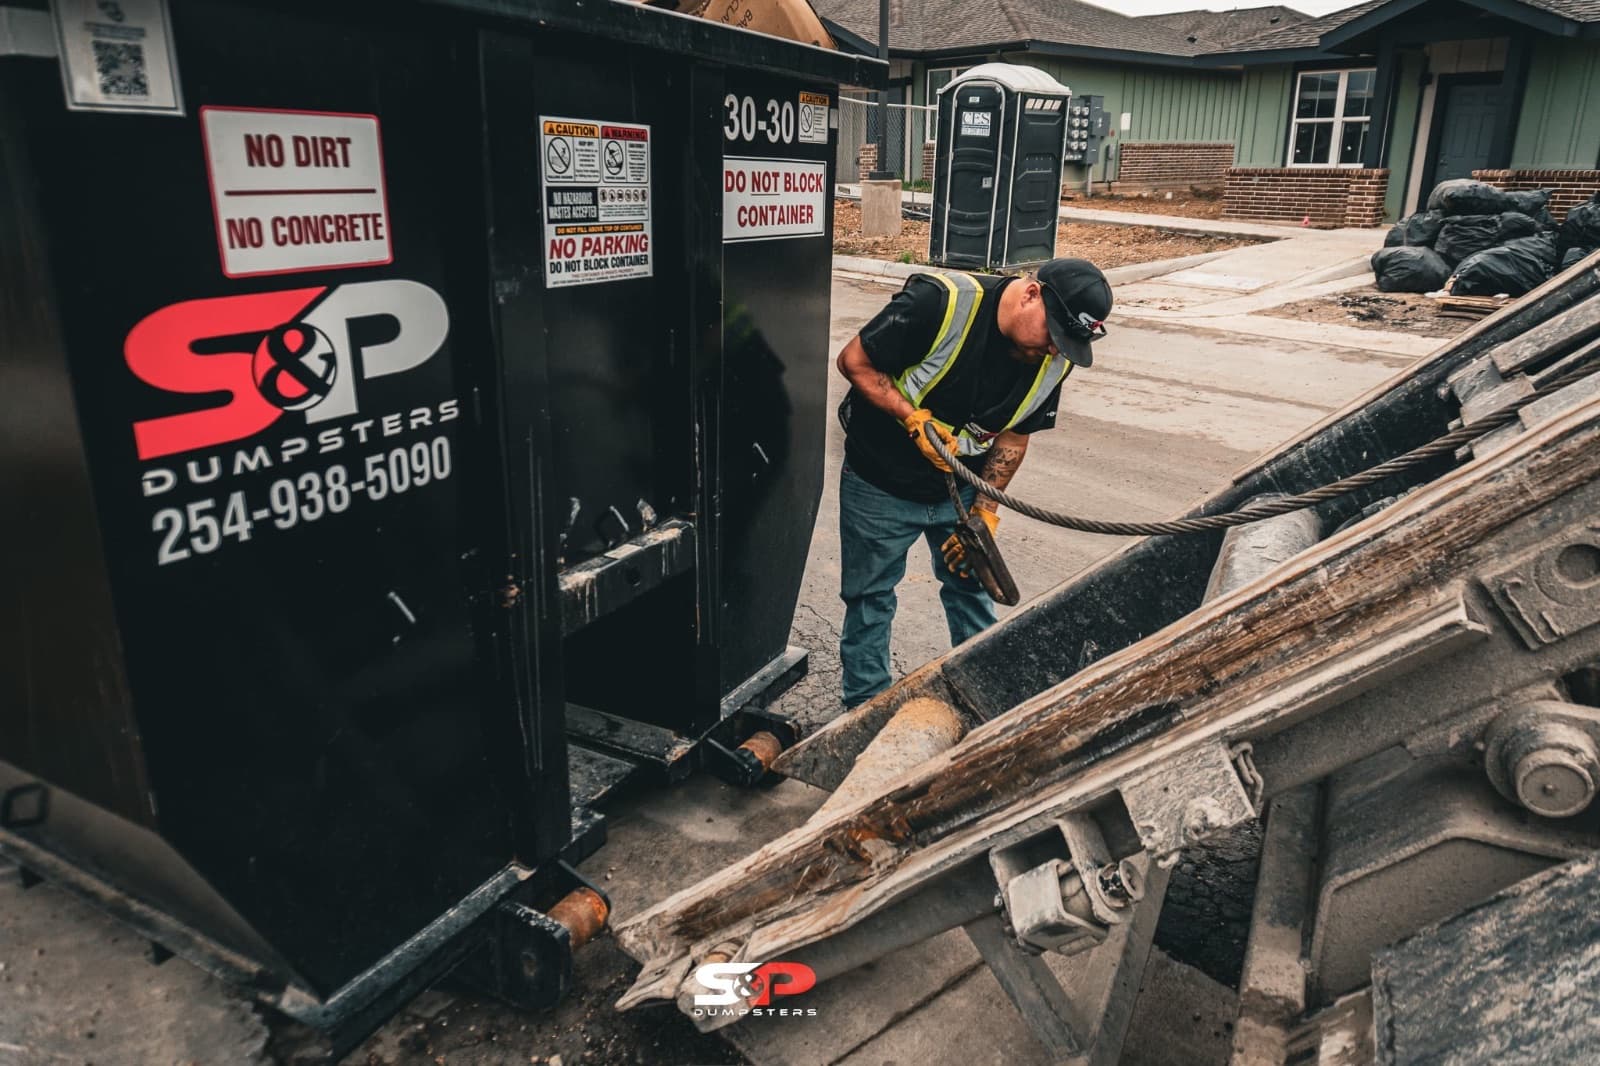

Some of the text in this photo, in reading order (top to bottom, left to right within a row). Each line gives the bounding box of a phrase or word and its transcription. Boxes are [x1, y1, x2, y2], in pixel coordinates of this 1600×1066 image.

[556, 124, 595, 136] CAUTION
[611, 128, 646, 140] WARNING
[724, 94, 794, 144] 30-30
[244, 133, 352, 168] NO DIRT
[725, 170, 823, 193] DO NOT BLOCK
[225, 213, 384, 249] NO CONCRETE
[737, 204, 814, 228] CONTAINER
[549, 234, 649, 260] NO PARKING
[550, 261, 562, 274] DO
[564, 259, 581, 273] NOT
[583, 257, 610, 271] BLOCK
[610, 254, 649, 268] CONTAINER
[124, 279, 449, 460] S&P
[142, 399, 460, 497] DUMPSTERS
[152, 436, 451, 566] 254-938-5090
